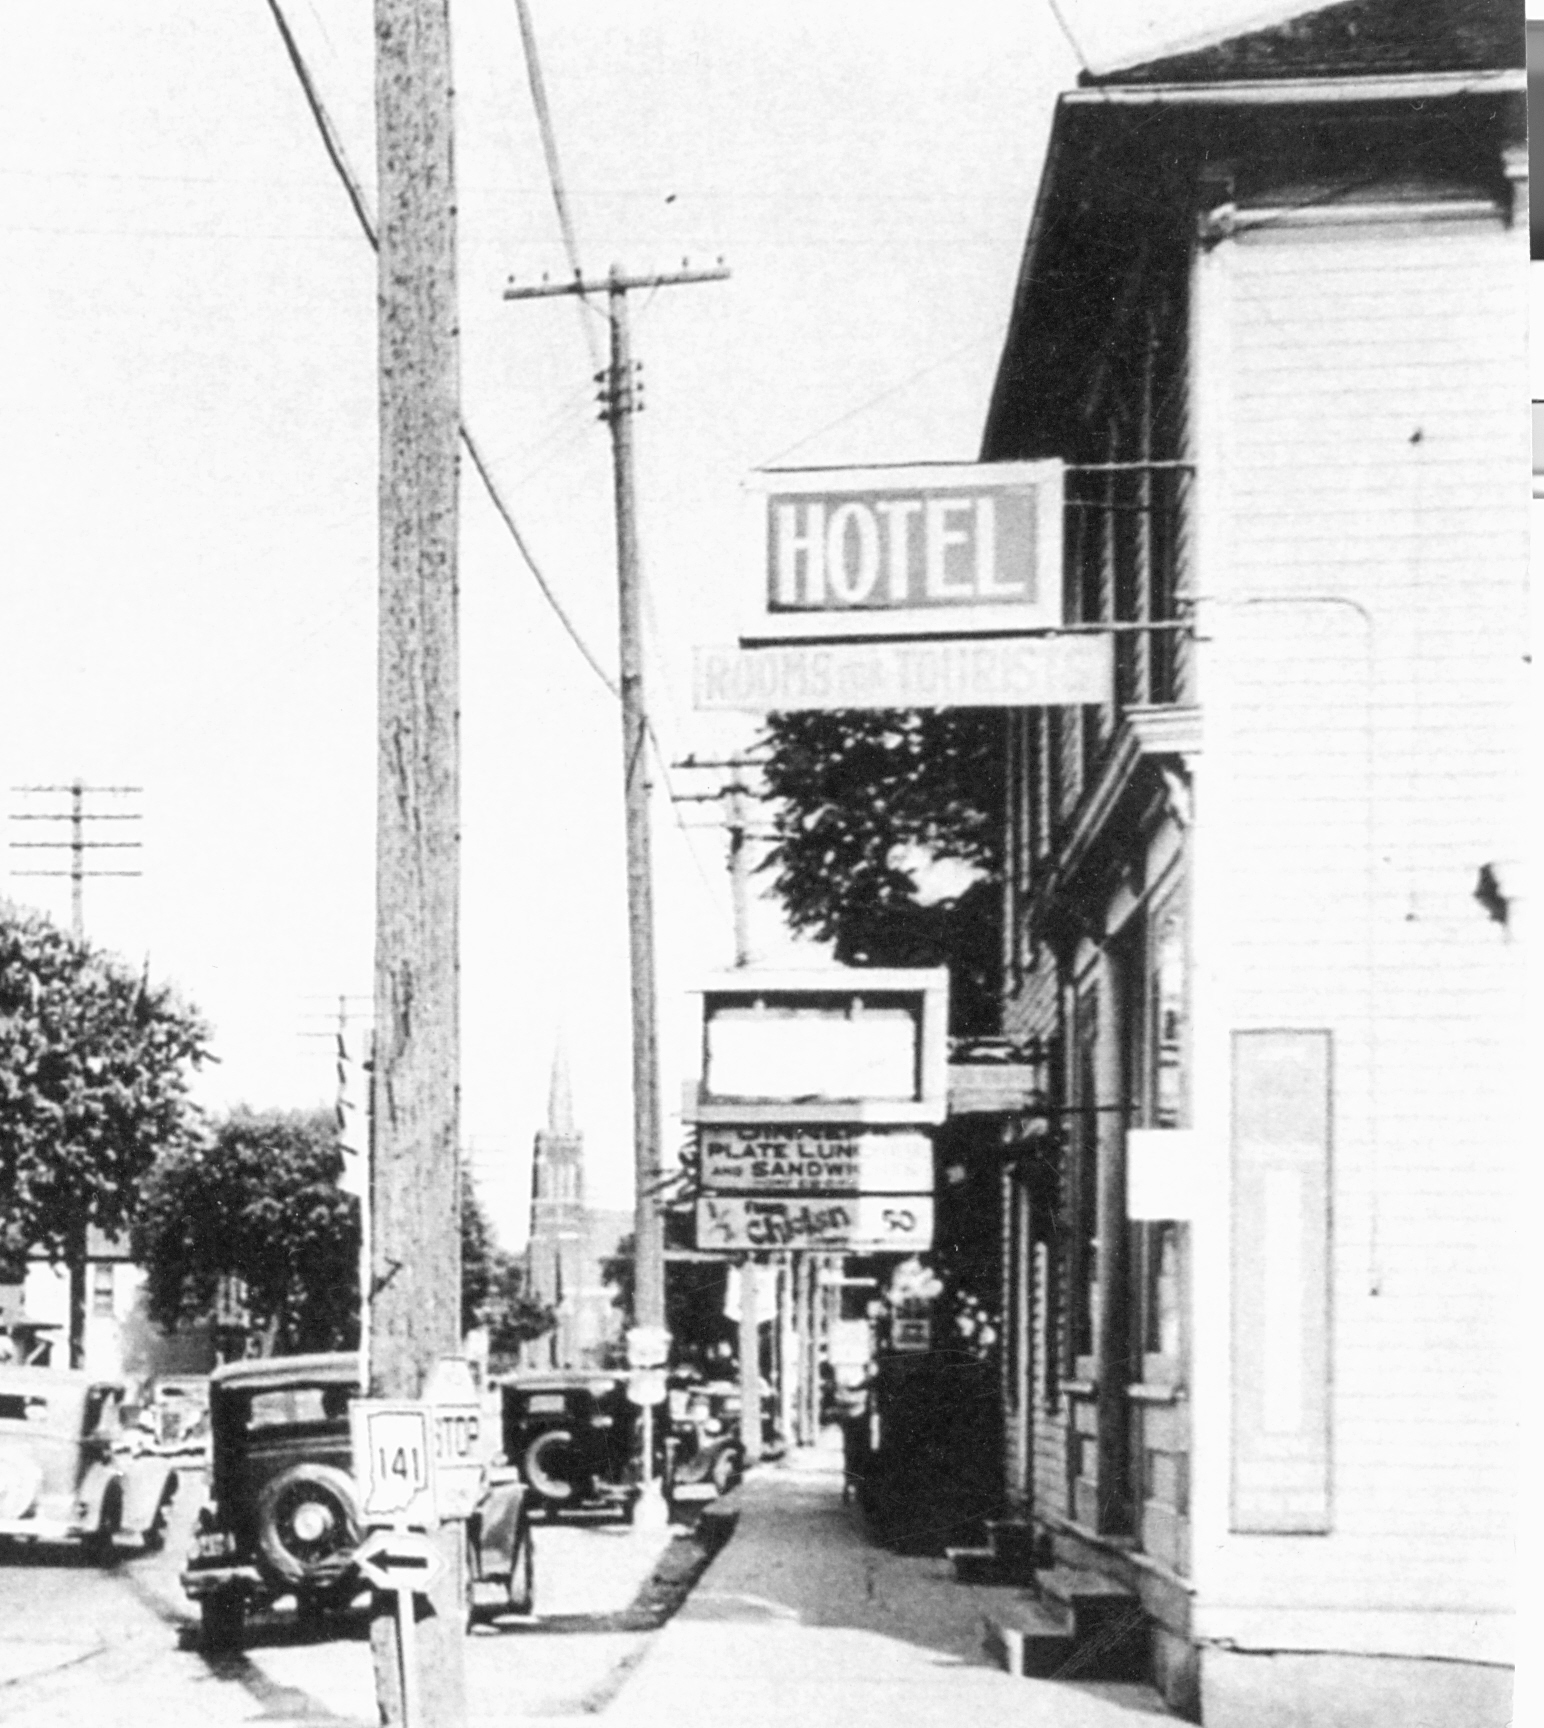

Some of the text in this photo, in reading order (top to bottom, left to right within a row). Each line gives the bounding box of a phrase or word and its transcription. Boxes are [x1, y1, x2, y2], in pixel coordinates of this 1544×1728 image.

[778, 497, 1024, 604] HOTEL
[705, 650, 834, 700] ROOMS
[707, 1142, 788, 1159] PLATE
[379, 1446, 420, 1481] 141
